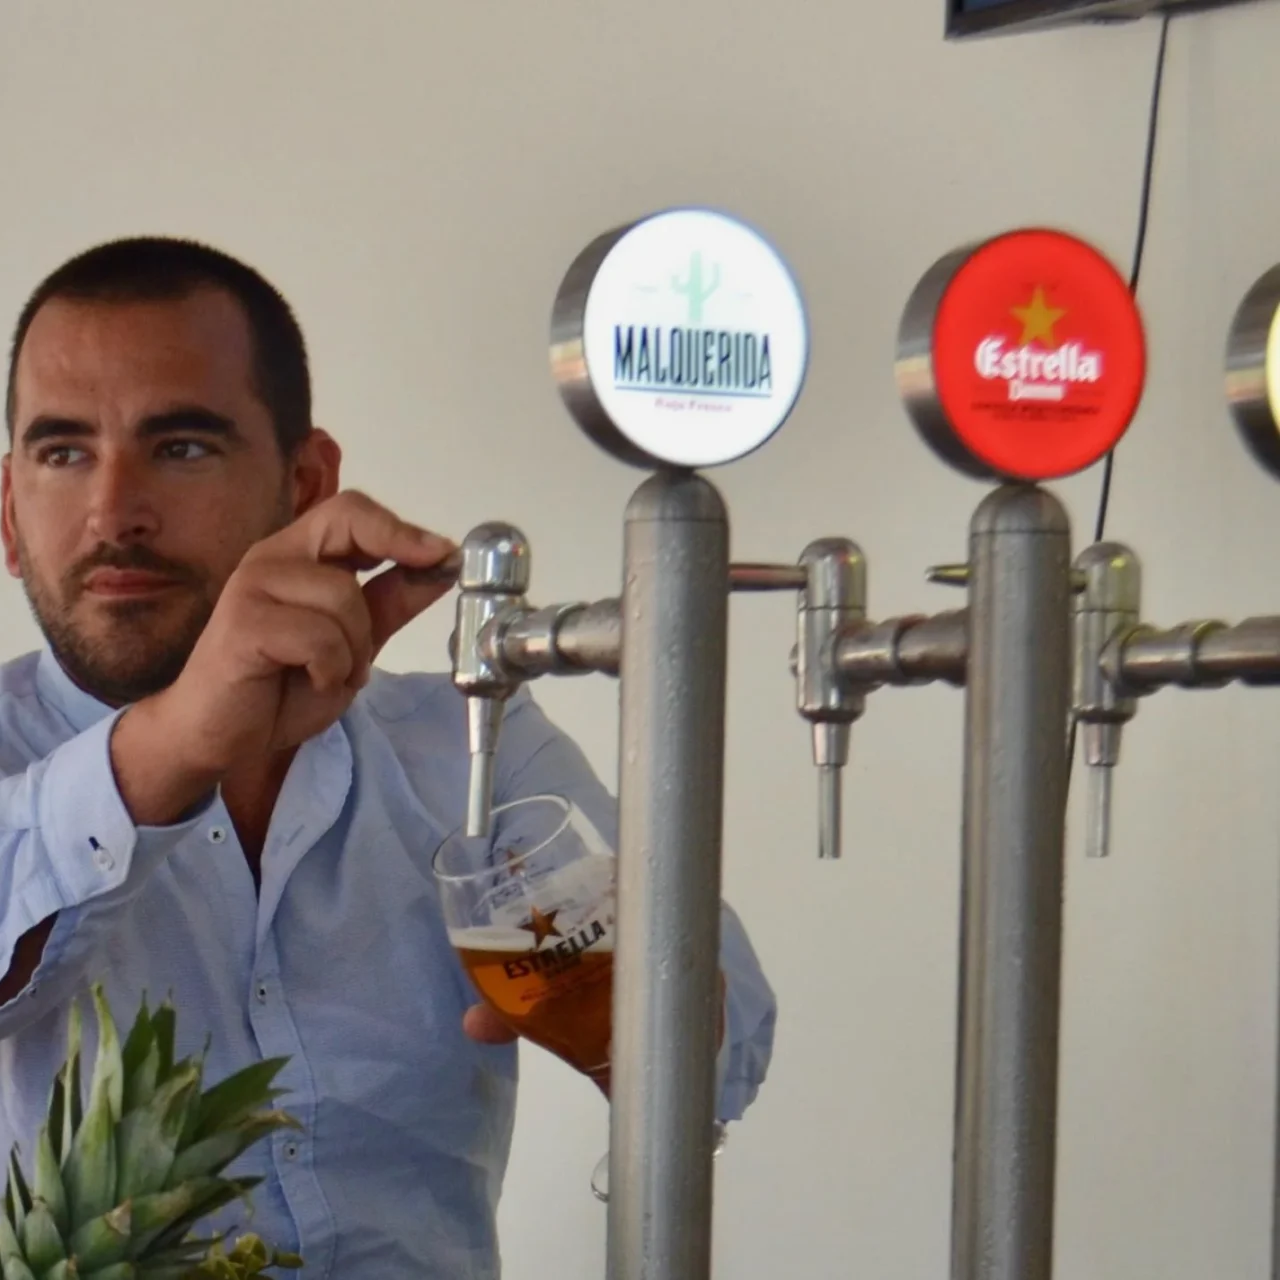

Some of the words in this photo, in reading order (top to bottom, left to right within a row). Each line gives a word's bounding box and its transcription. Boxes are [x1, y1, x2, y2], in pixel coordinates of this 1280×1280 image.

[614, 323, 773, 390] MALQUERIDA
[973, 335, 1103, 383] Estrella
[503, 920, 606, 980] ESTRELLA
